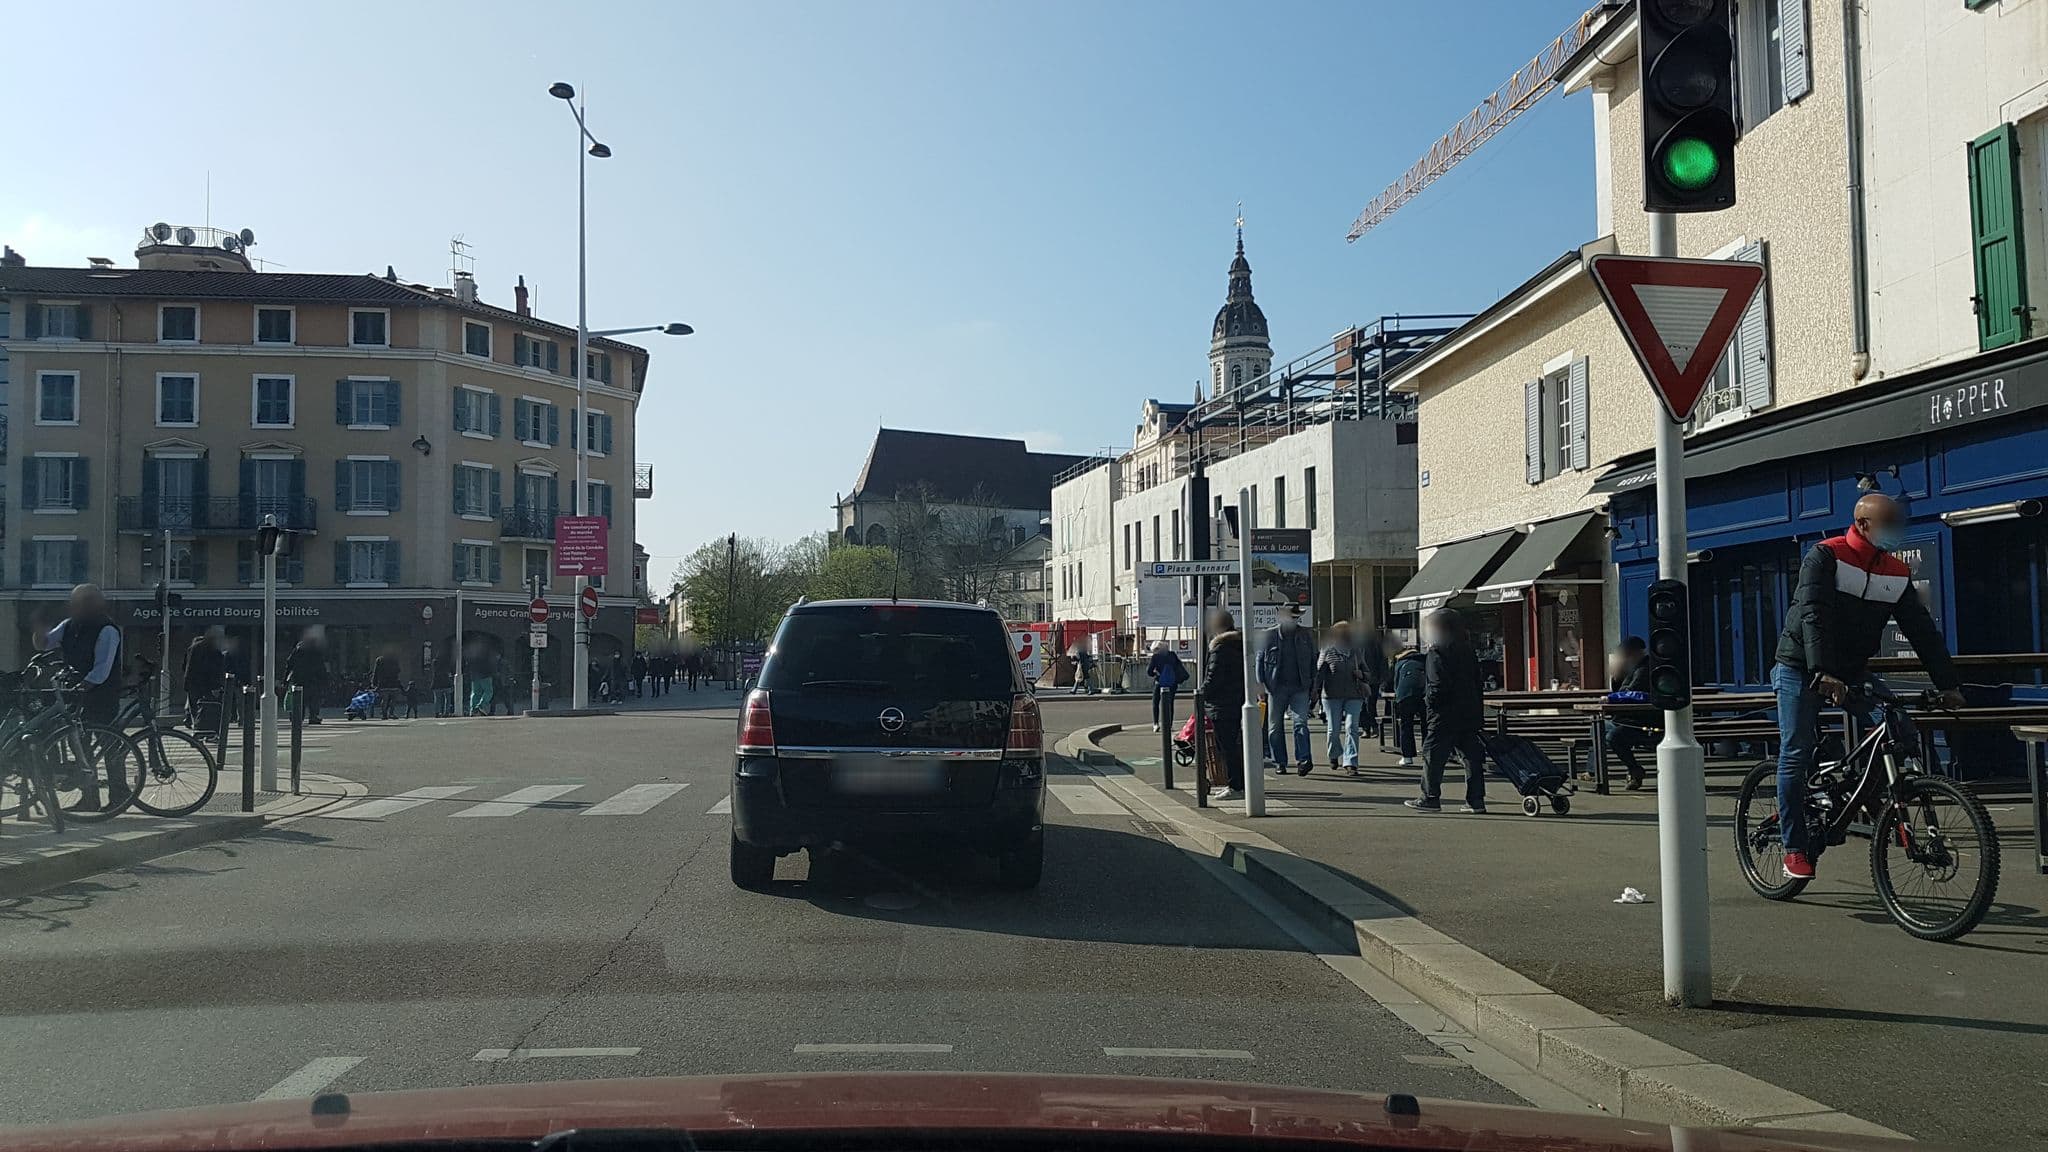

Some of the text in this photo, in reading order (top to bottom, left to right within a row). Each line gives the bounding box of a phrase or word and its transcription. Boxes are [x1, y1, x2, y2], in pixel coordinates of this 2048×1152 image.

[1167, 565, 1191, 573] Place
[1195, 563, 1231, 572] Bernard
[133, 606, 320, 619] Agece Grand Bourg obilités
[475, 608, 508, 619] Agence
[510, 609, 530, 618] Gran
